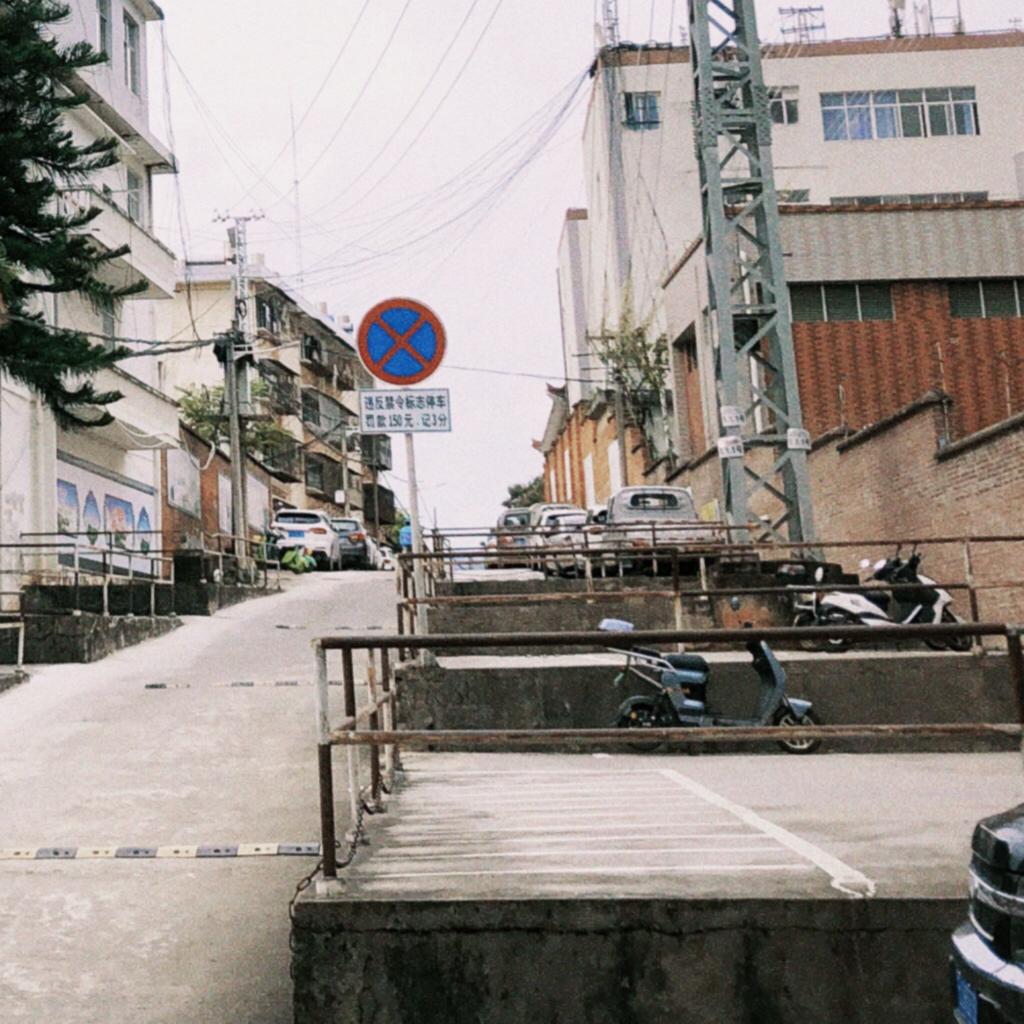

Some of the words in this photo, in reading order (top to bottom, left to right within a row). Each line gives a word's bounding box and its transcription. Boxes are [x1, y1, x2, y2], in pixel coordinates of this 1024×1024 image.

[364, 394, 446, 410] 违反禁令标志停车
